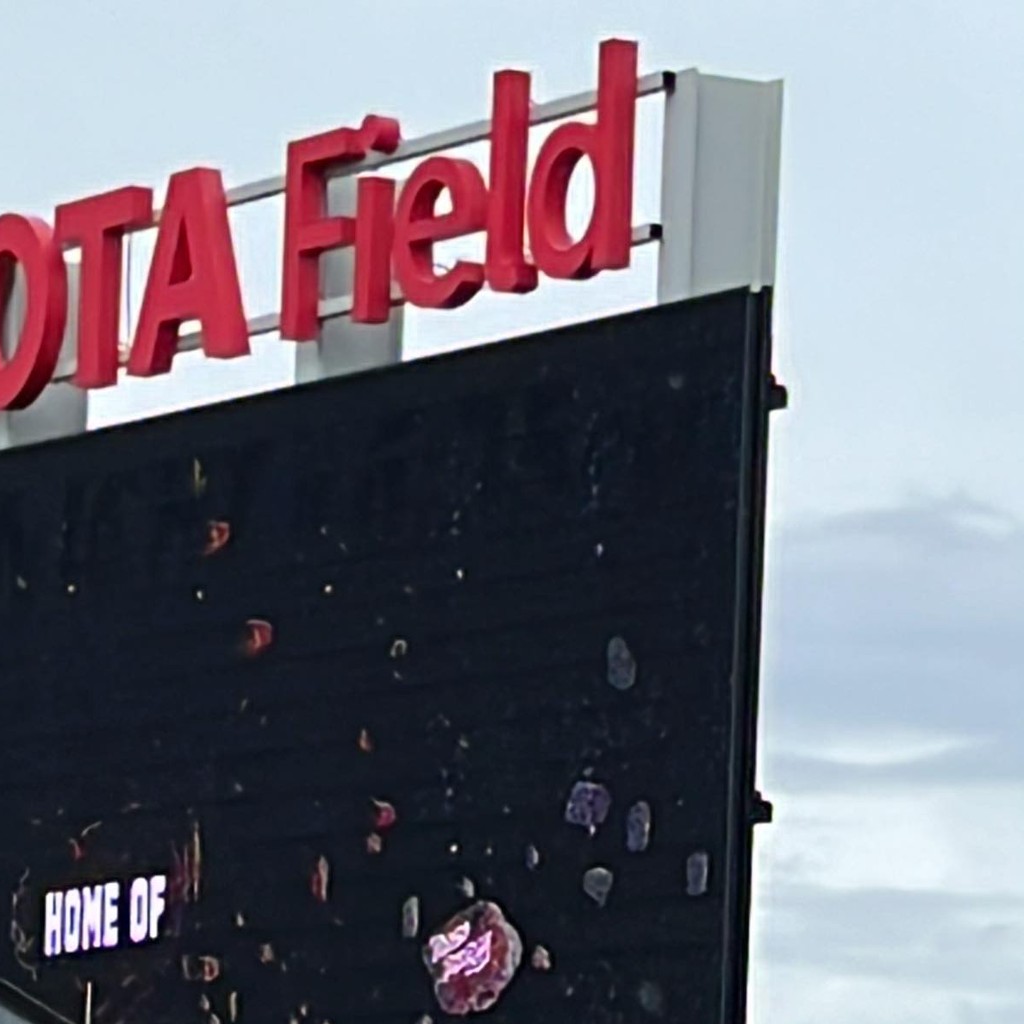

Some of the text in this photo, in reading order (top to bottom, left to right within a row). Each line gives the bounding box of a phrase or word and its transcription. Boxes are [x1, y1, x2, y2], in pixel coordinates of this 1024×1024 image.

[281, 39, 638, 342] Field
[44, 874, 166, 957] HOME OF
